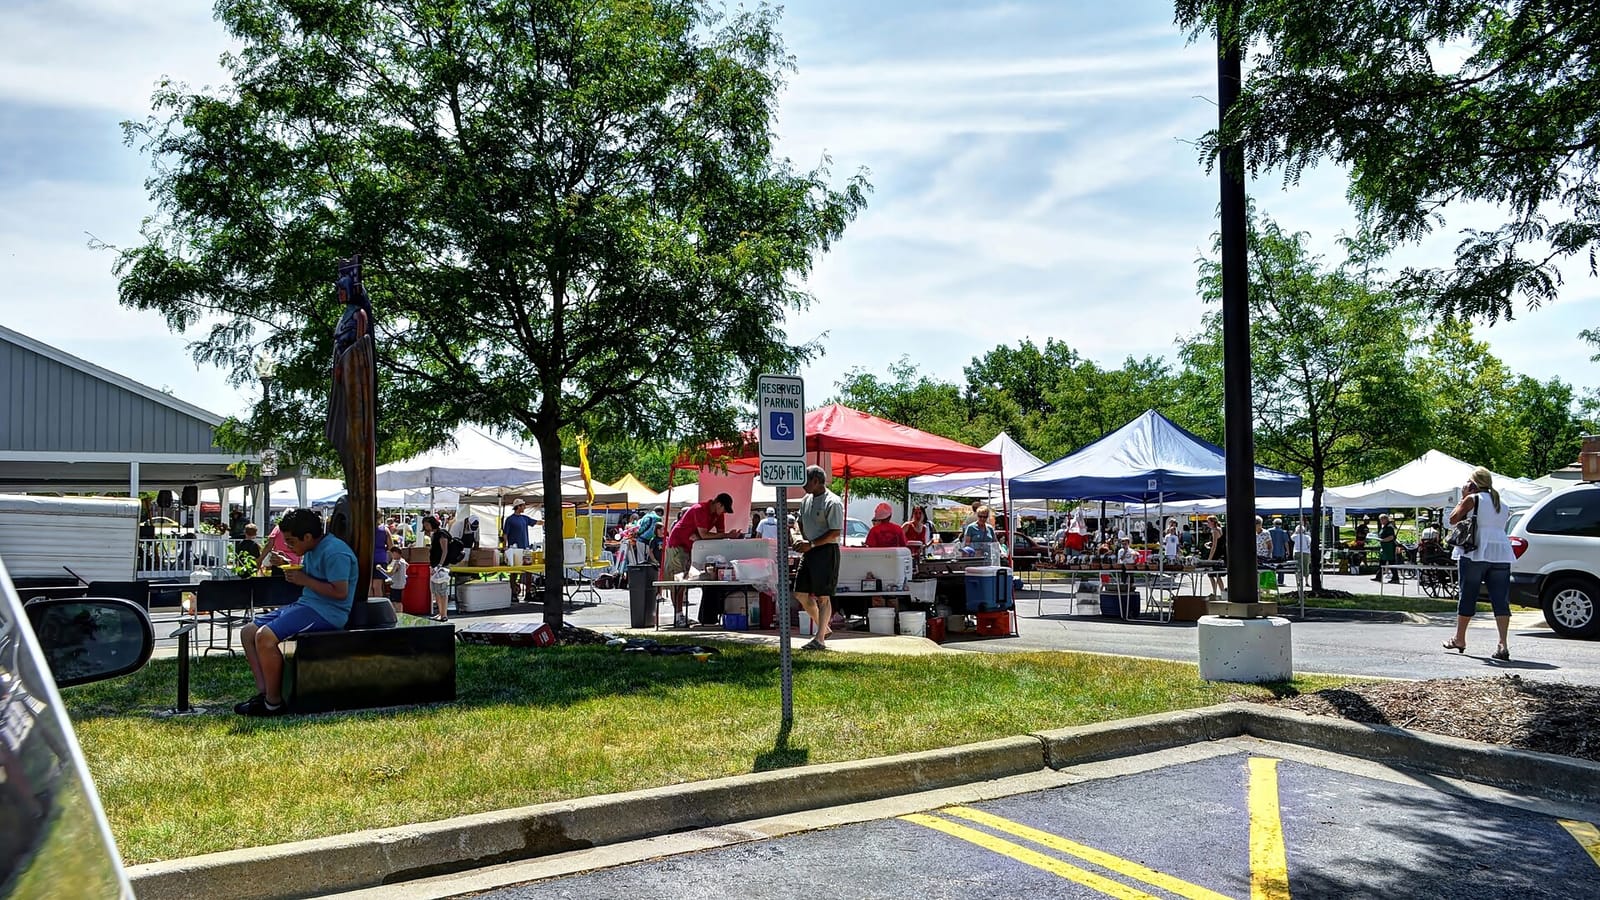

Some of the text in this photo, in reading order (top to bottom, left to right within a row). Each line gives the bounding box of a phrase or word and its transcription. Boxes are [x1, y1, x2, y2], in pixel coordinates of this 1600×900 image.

[761, 383, 801, 395] RESERVED
[764, 397, 799, 409] PARKING
[787, 465, 803, 481] FINE
